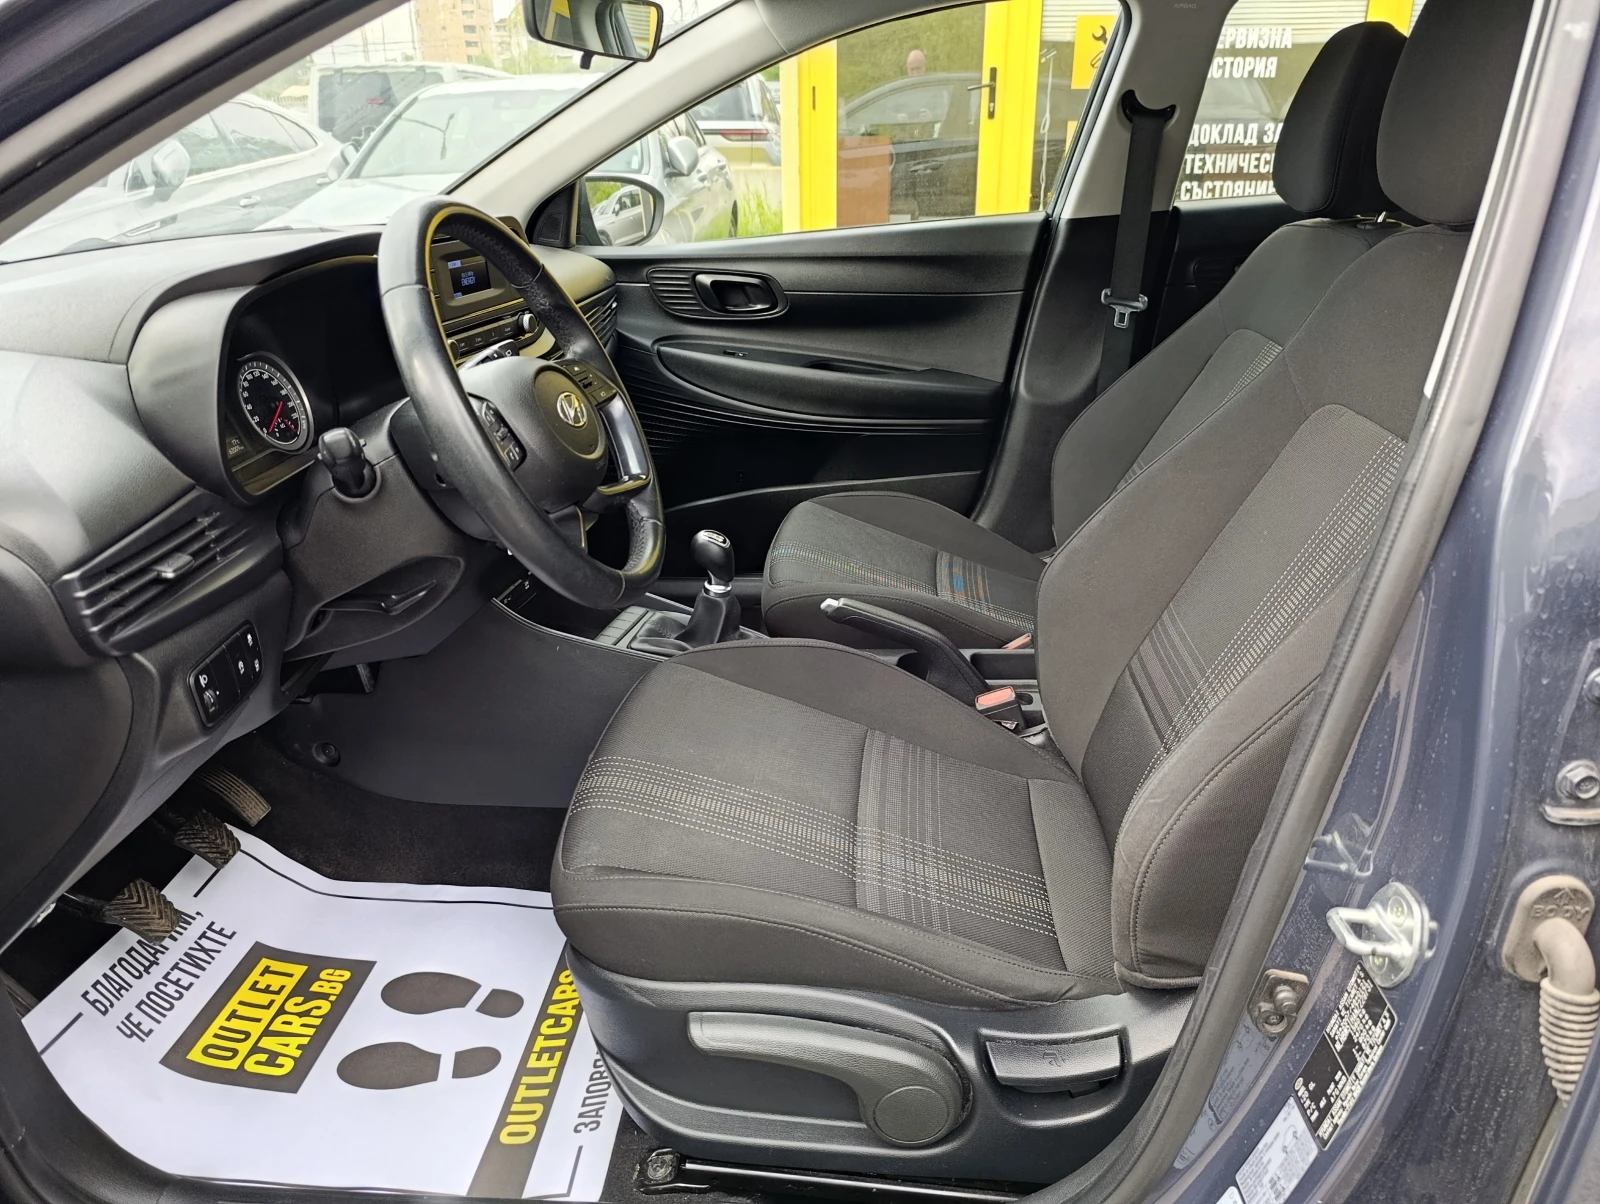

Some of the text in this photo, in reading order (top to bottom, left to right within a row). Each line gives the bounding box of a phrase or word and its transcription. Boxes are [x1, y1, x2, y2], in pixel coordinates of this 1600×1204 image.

[1188, 123, 1258, 147] ДОКЛАД
[1532, 904, 1590, 921] BODY
[116, 921, 237, 1043] ЧЕ ПОСЕТИХТЕ
[201, 965, 296, 1062] OUTLET
[243, 968, 352, 1076] CARS.BG
